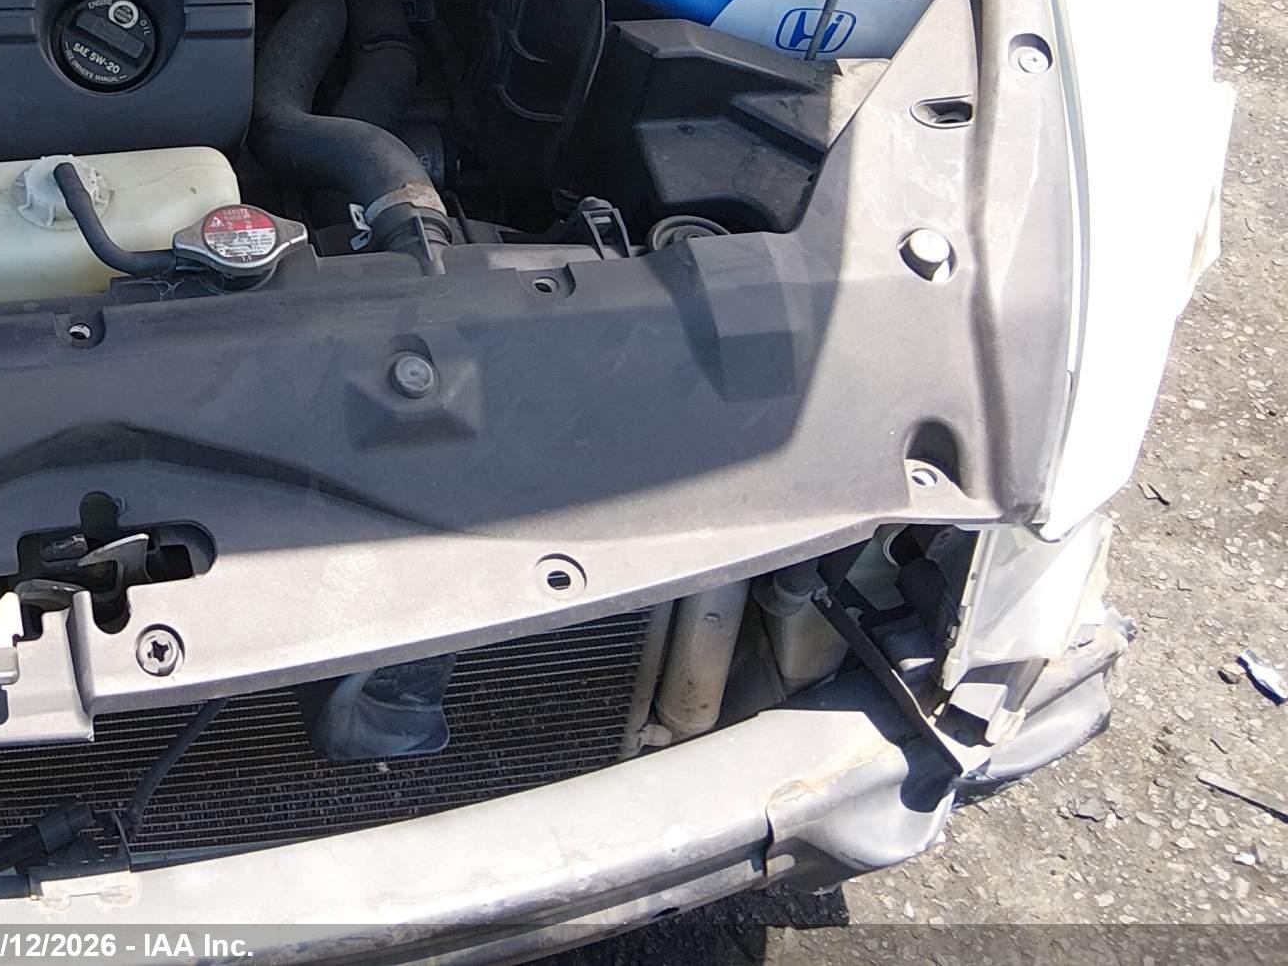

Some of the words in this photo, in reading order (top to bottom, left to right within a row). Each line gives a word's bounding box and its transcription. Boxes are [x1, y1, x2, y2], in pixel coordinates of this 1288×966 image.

[140, 19, 151, 37] OIL
[72, 42, 91, 58] SAE
[89, 52, 121, 75] 5W-20
